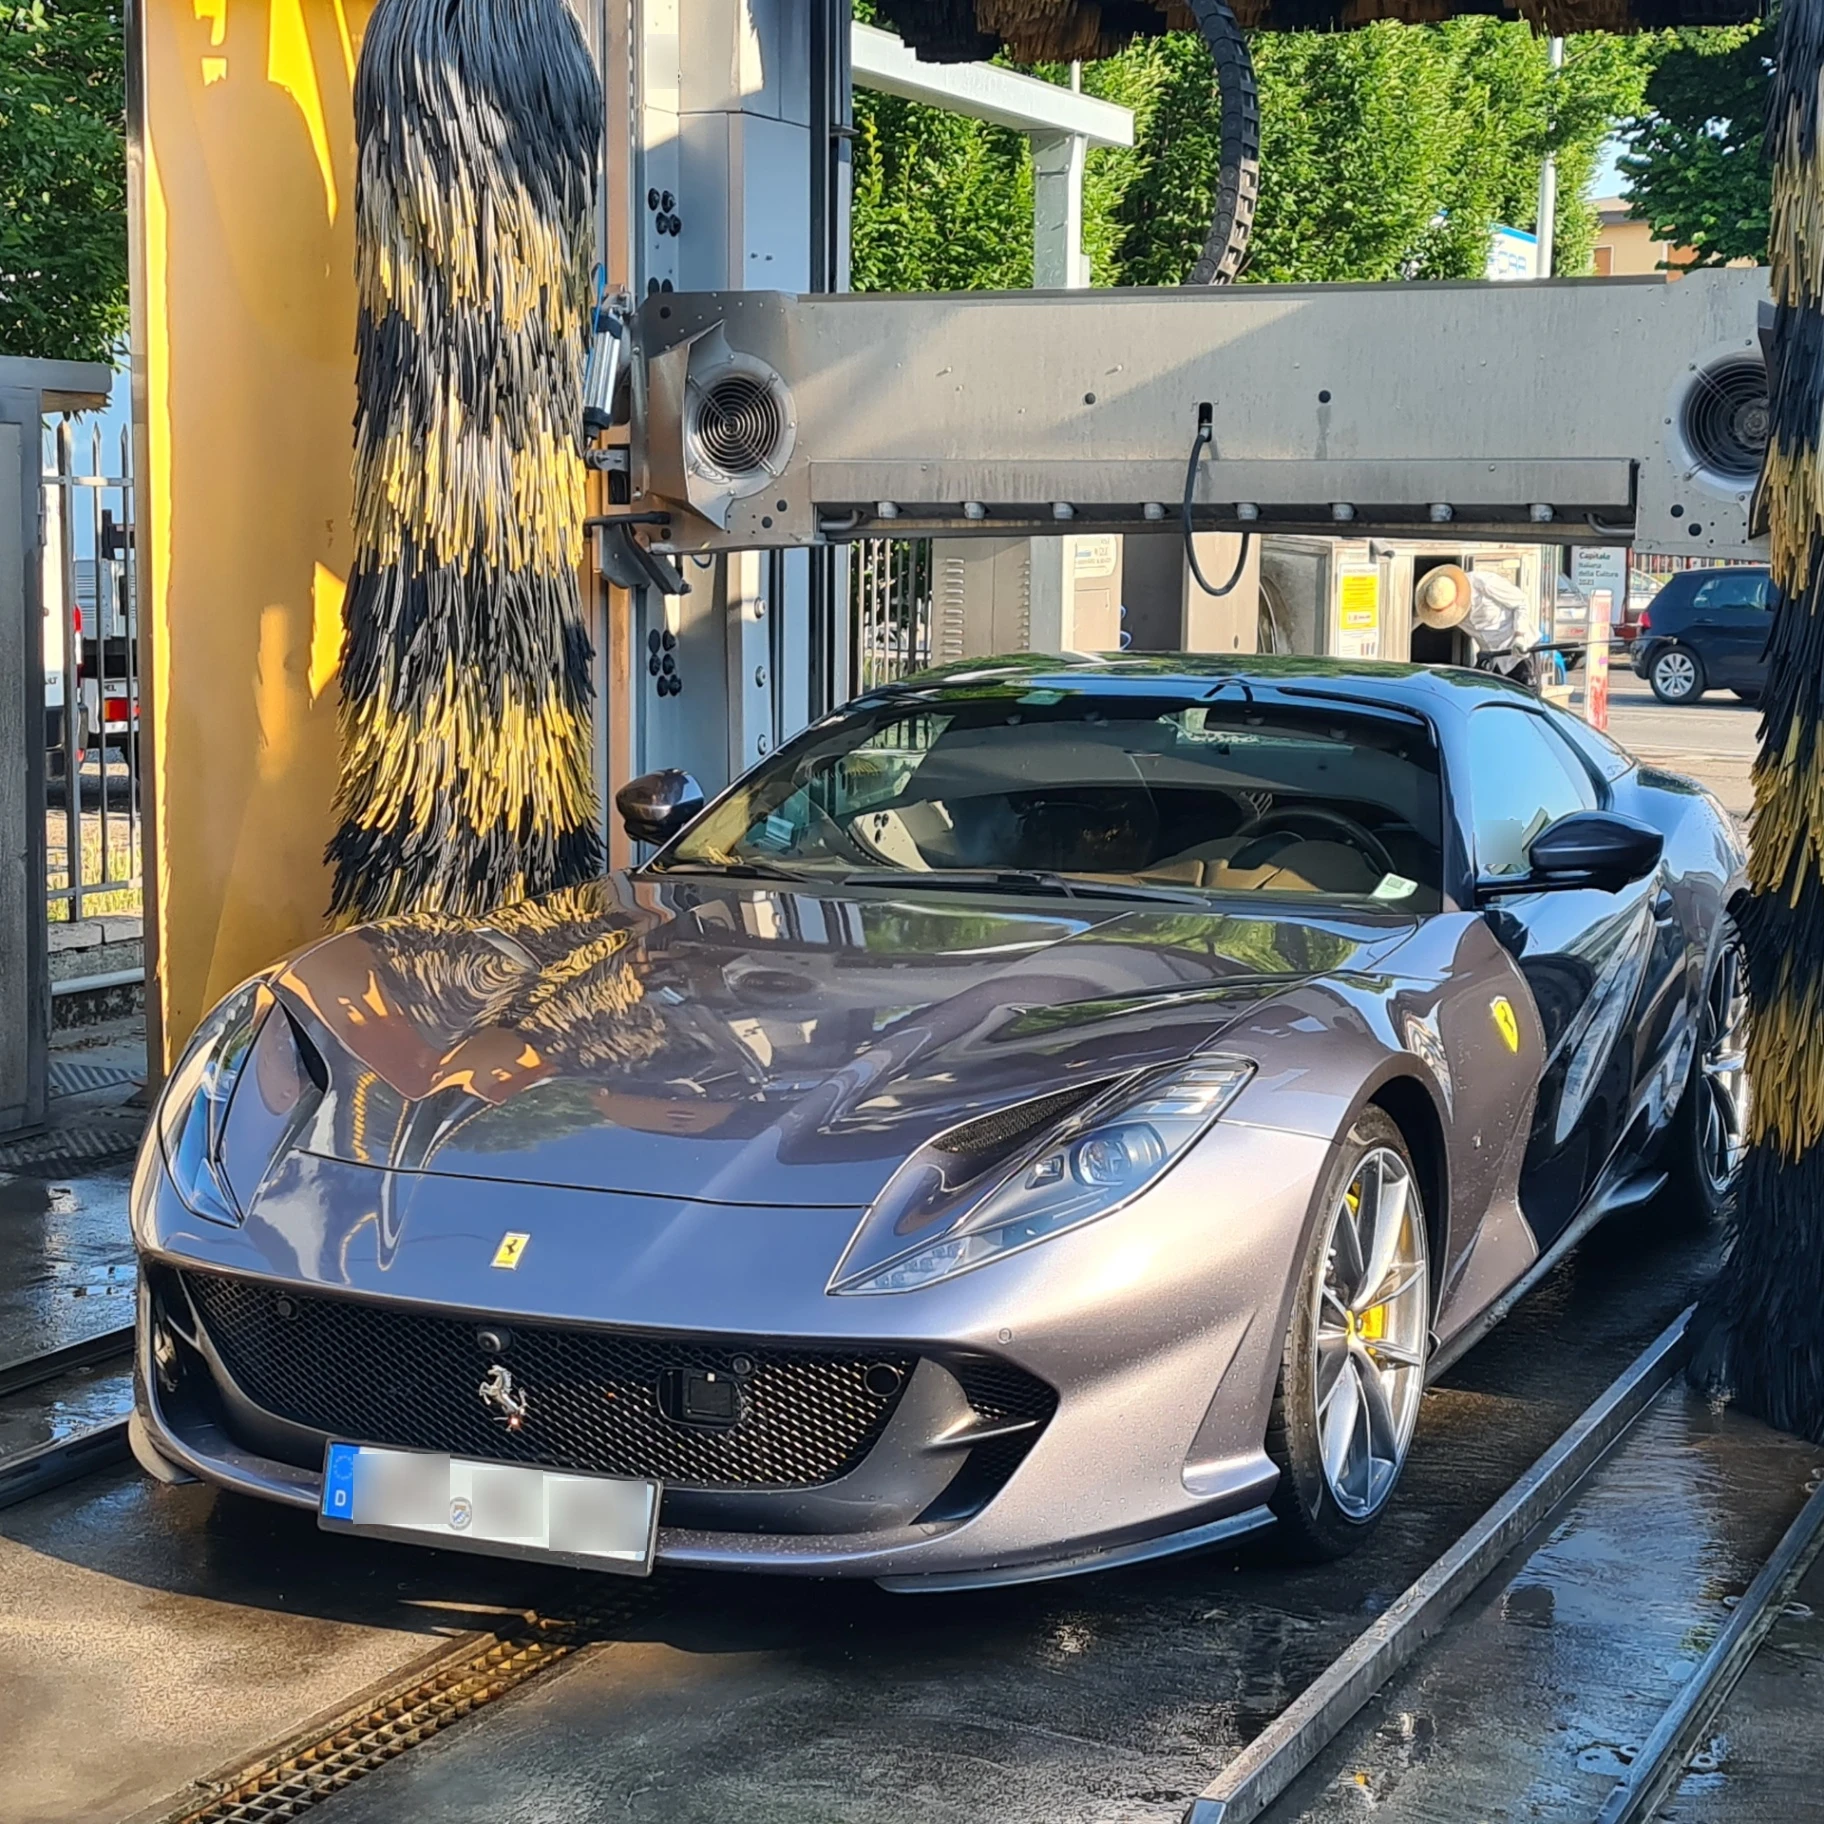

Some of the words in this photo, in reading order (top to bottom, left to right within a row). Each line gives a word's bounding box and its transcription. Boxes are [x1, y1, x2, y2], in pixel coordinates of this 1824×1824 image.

[1578, 550, 1611, 561] Capitale
[1595, 570, 1619, 578] Cultura
[334, 1489, 347, 1507] D
